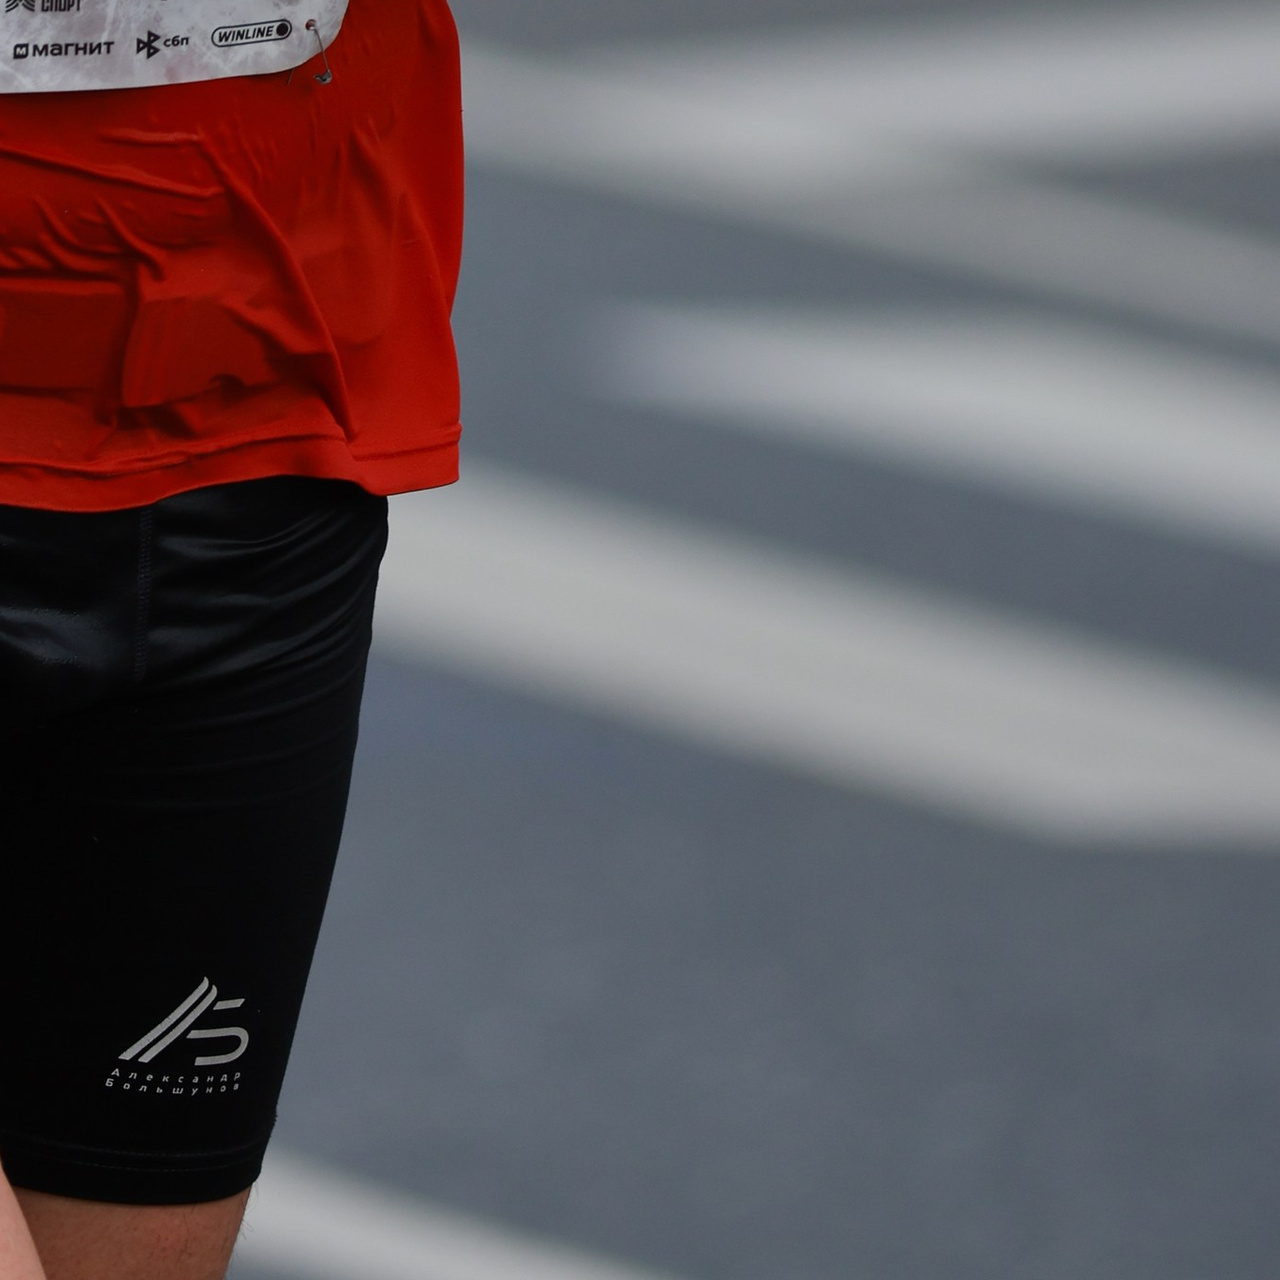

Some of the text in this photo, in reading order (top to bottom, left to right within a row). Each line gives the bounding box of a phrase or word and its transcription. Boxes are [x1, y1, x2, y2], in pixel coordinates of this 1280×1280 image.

[218, 25, 275, 43] WINLINE
[110, 1067, 241, 1083] Александр
[105, 1077, 240, 1096] Большунов
